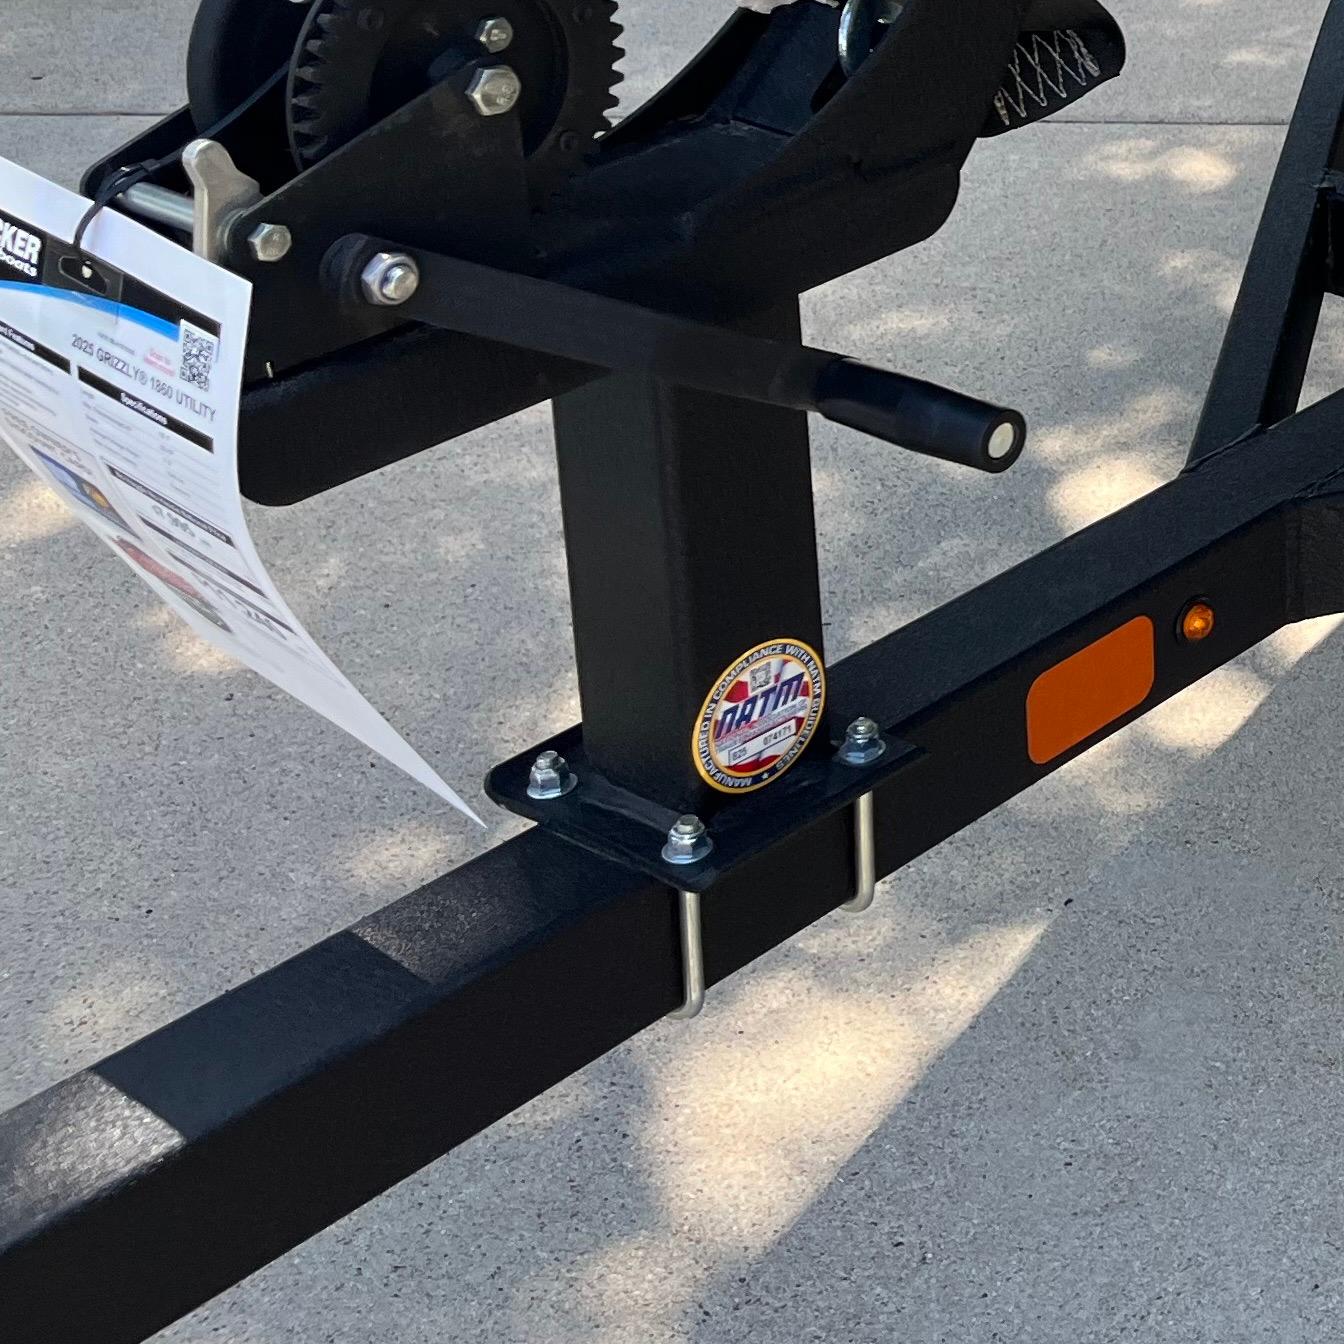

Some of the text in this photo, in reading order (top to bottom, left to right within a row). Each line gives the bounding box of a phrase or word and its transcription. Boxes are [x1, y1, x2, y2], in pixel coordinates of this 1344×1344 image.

[71, 334, 94, 356] 2025
[150, 376, 173, 400] 1860
[176, 389, 217, 422] UTILITY
[713, 644, 783, 700] COMPLIANCE
[785, 644, 810, 664] WITH
[715, 672, 805, 739] NATM
